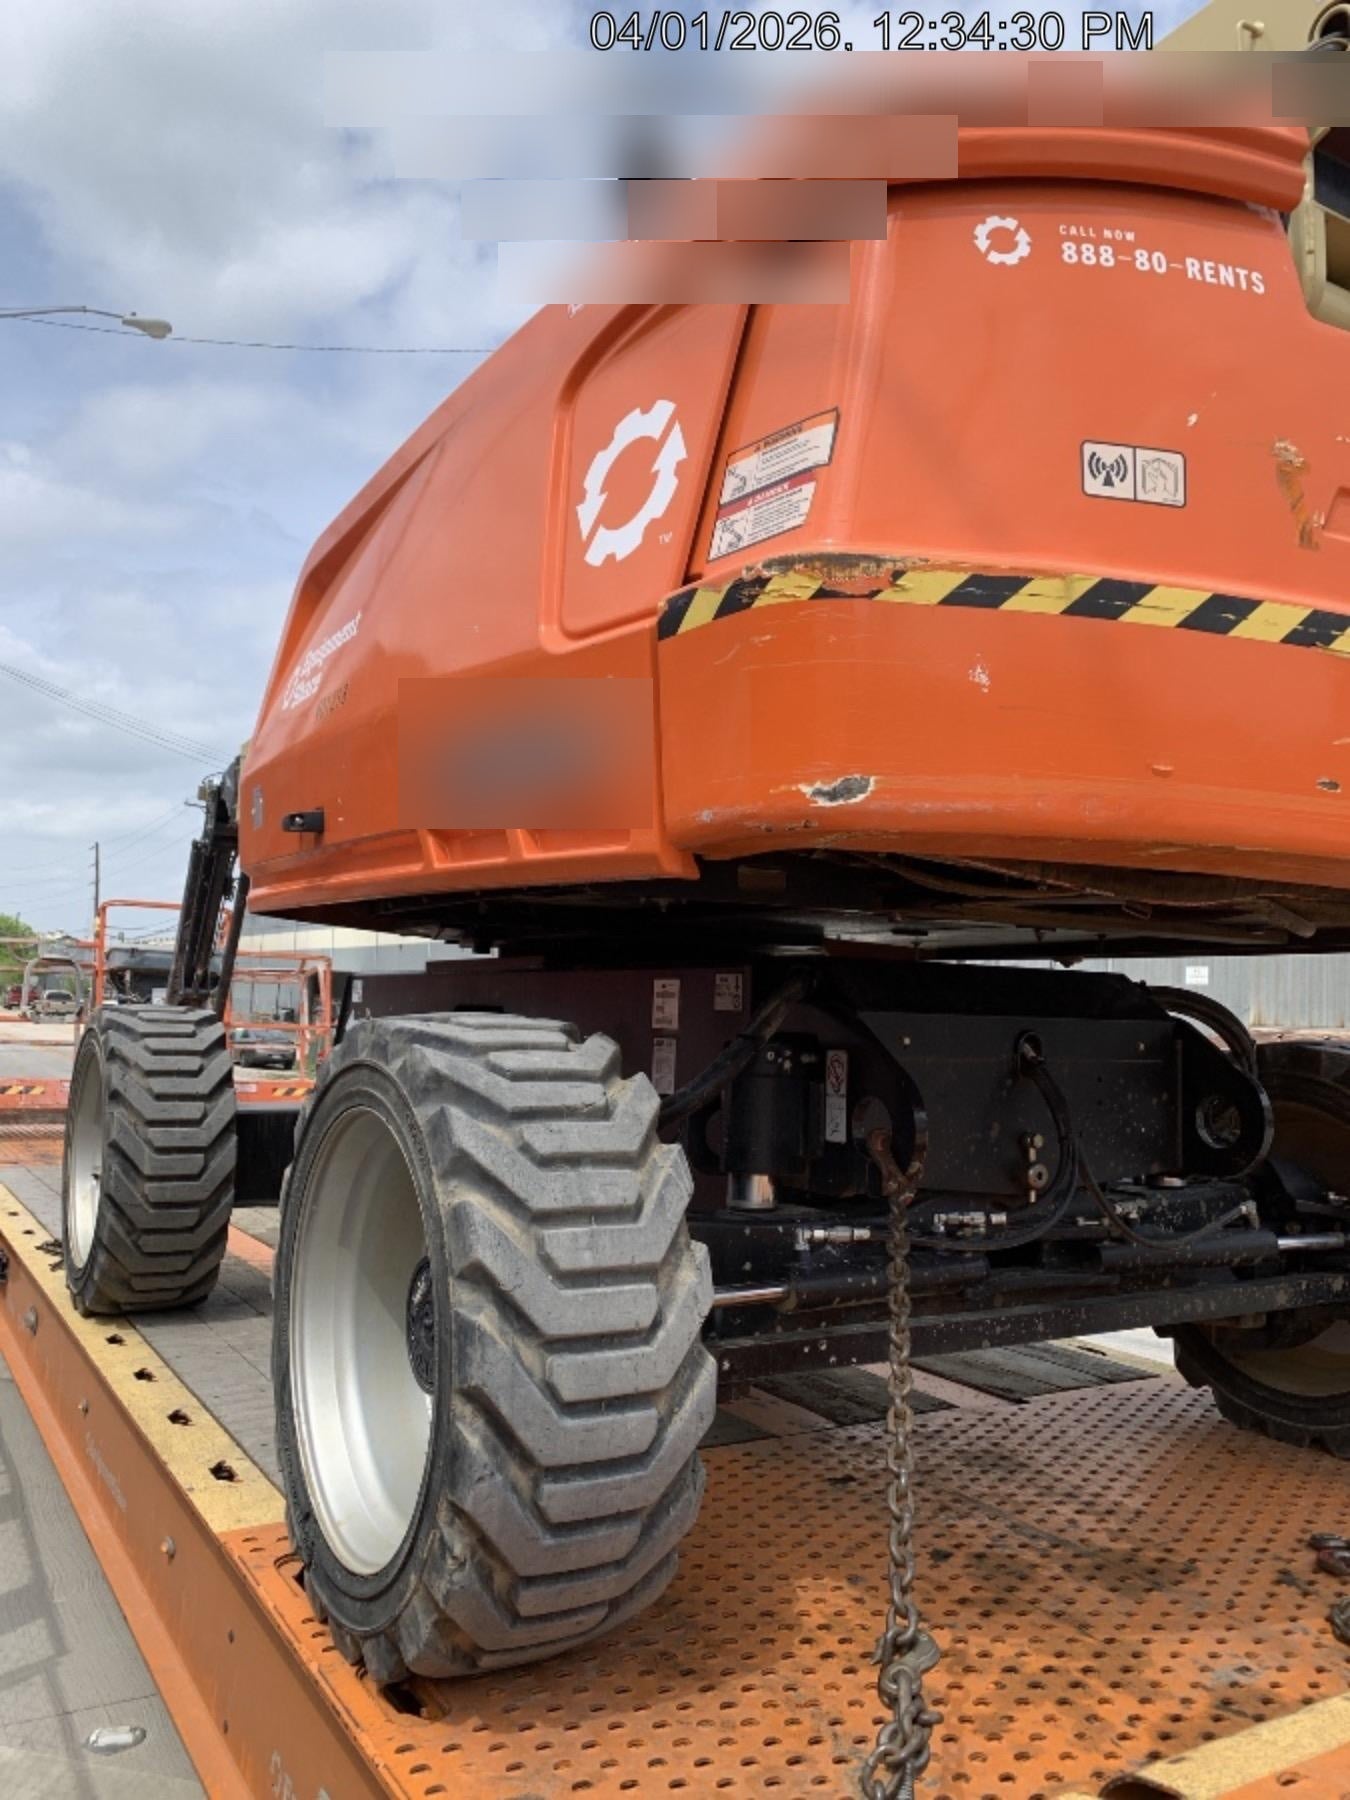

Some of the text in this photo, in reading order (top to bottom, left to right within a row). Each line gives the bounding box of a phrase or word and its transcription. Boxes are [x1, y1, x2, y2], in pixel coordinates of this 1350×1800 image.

[1059, 224, 1135, 242] CALL NOW
[1061, 241, 1265, 294] 888-80-RENTS
